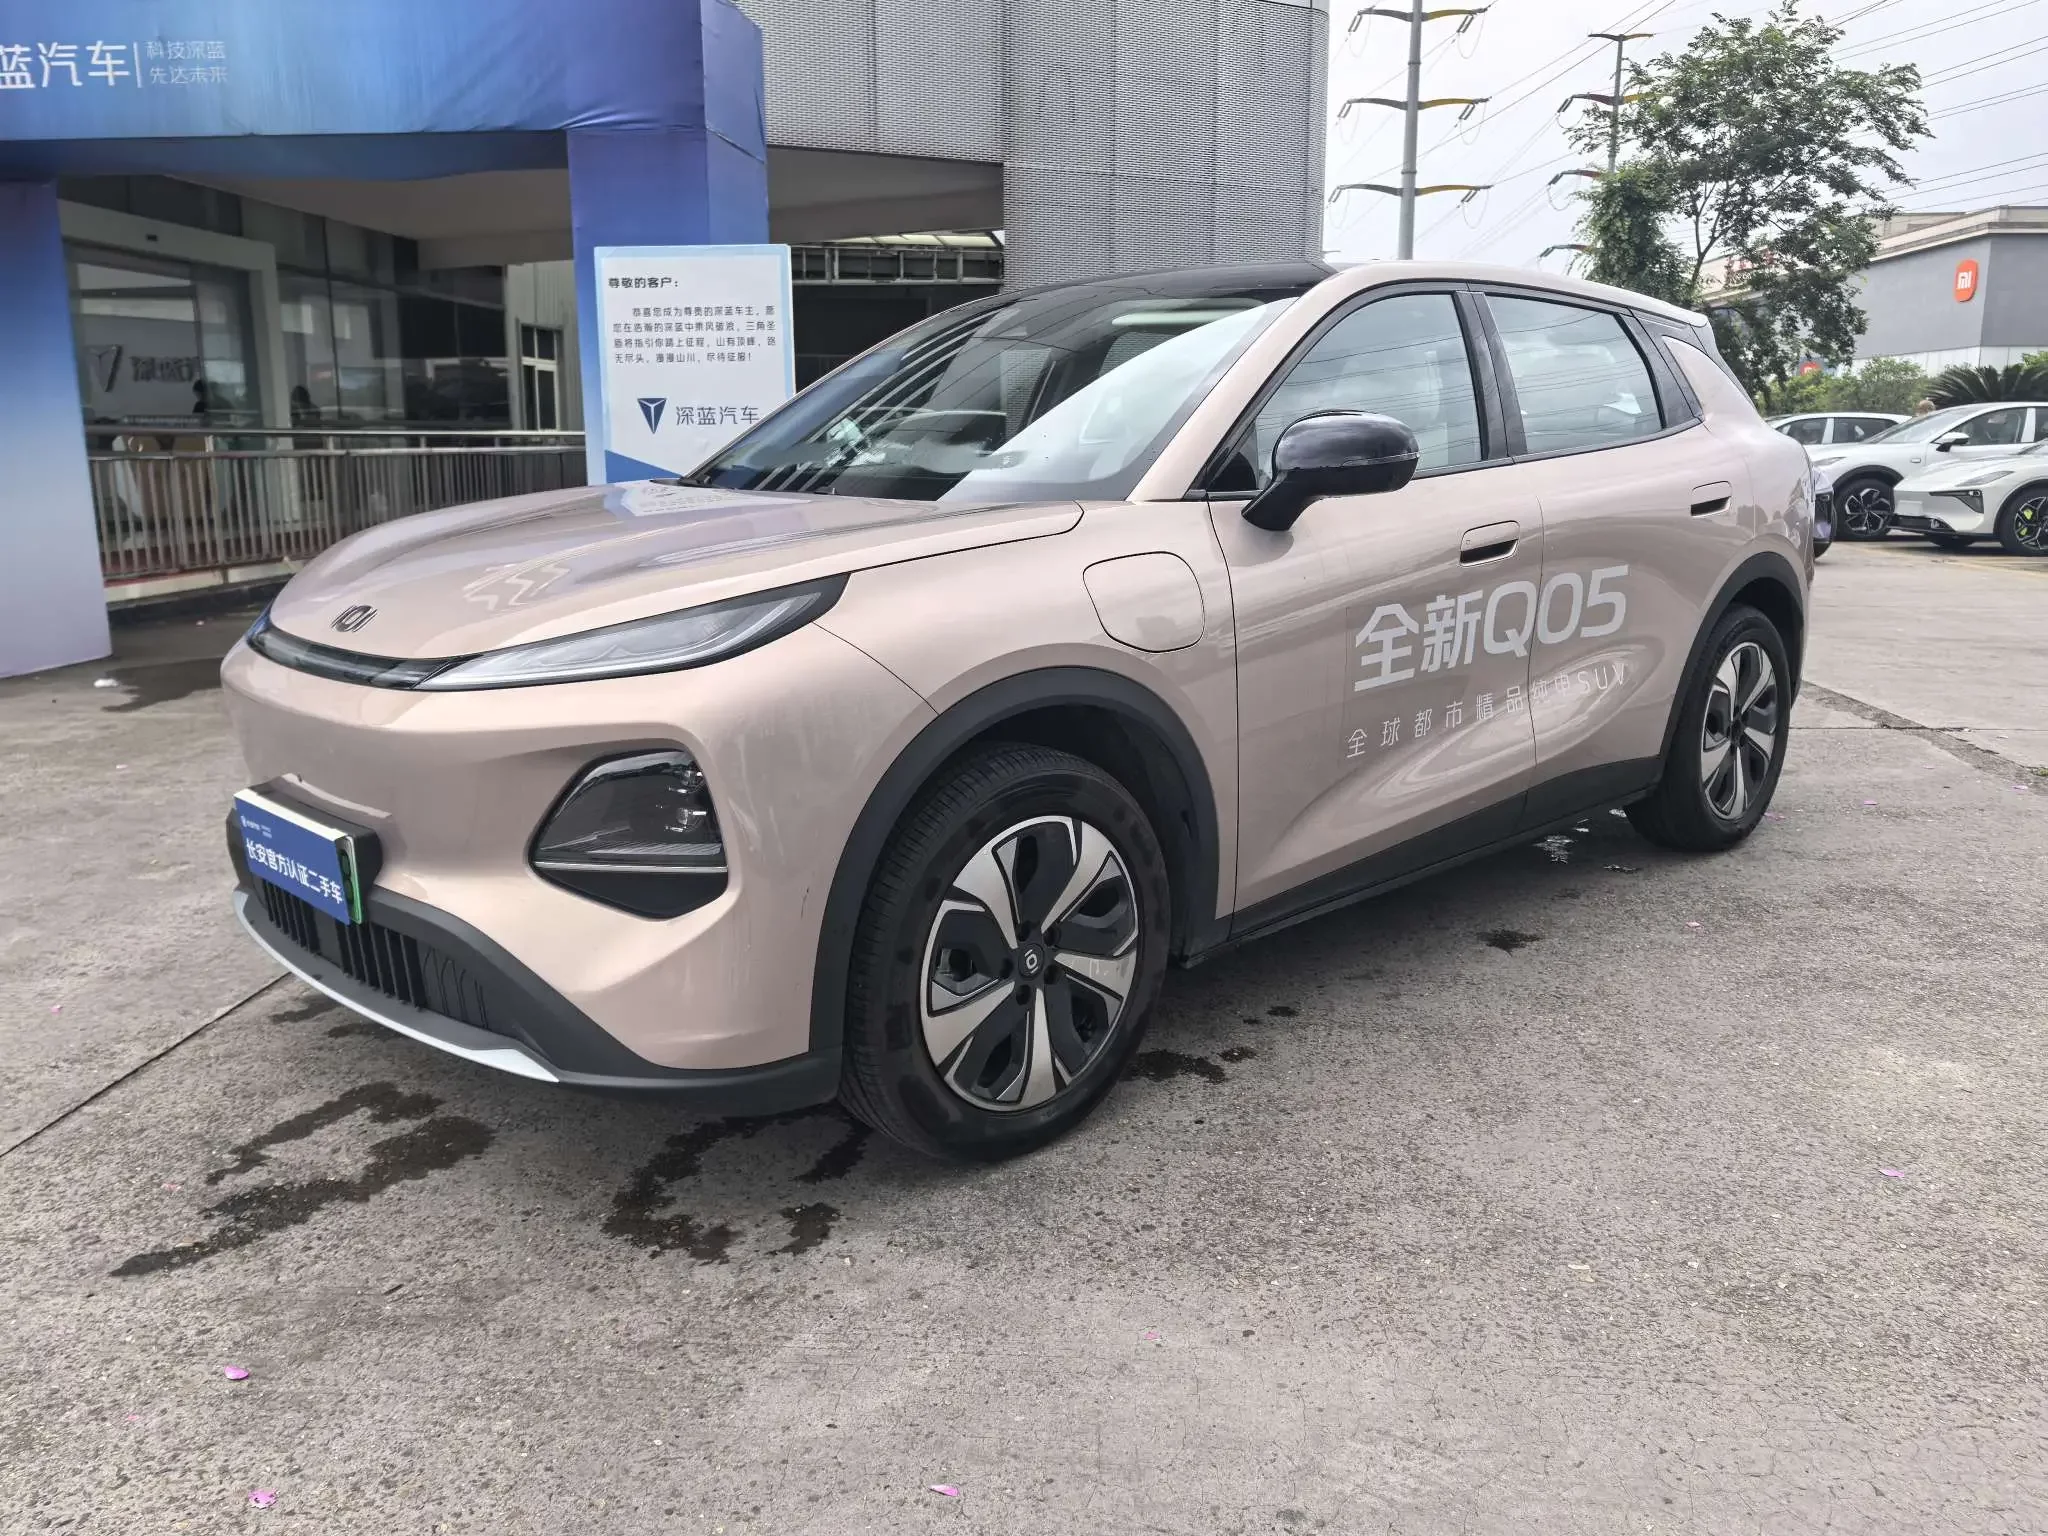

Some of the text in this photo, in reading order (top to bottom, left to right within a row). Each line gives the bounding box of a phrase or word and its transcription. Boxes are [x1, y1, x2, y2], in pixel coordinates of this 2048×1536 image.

[608, 277, 679, 289] 尊敬的客户：
[676, 406, 760, 426] 深蓝汽车
[1354, 565, 1630, 692] 全新Q05
[246, 837, 343, 904] 长安官方认证二手车
